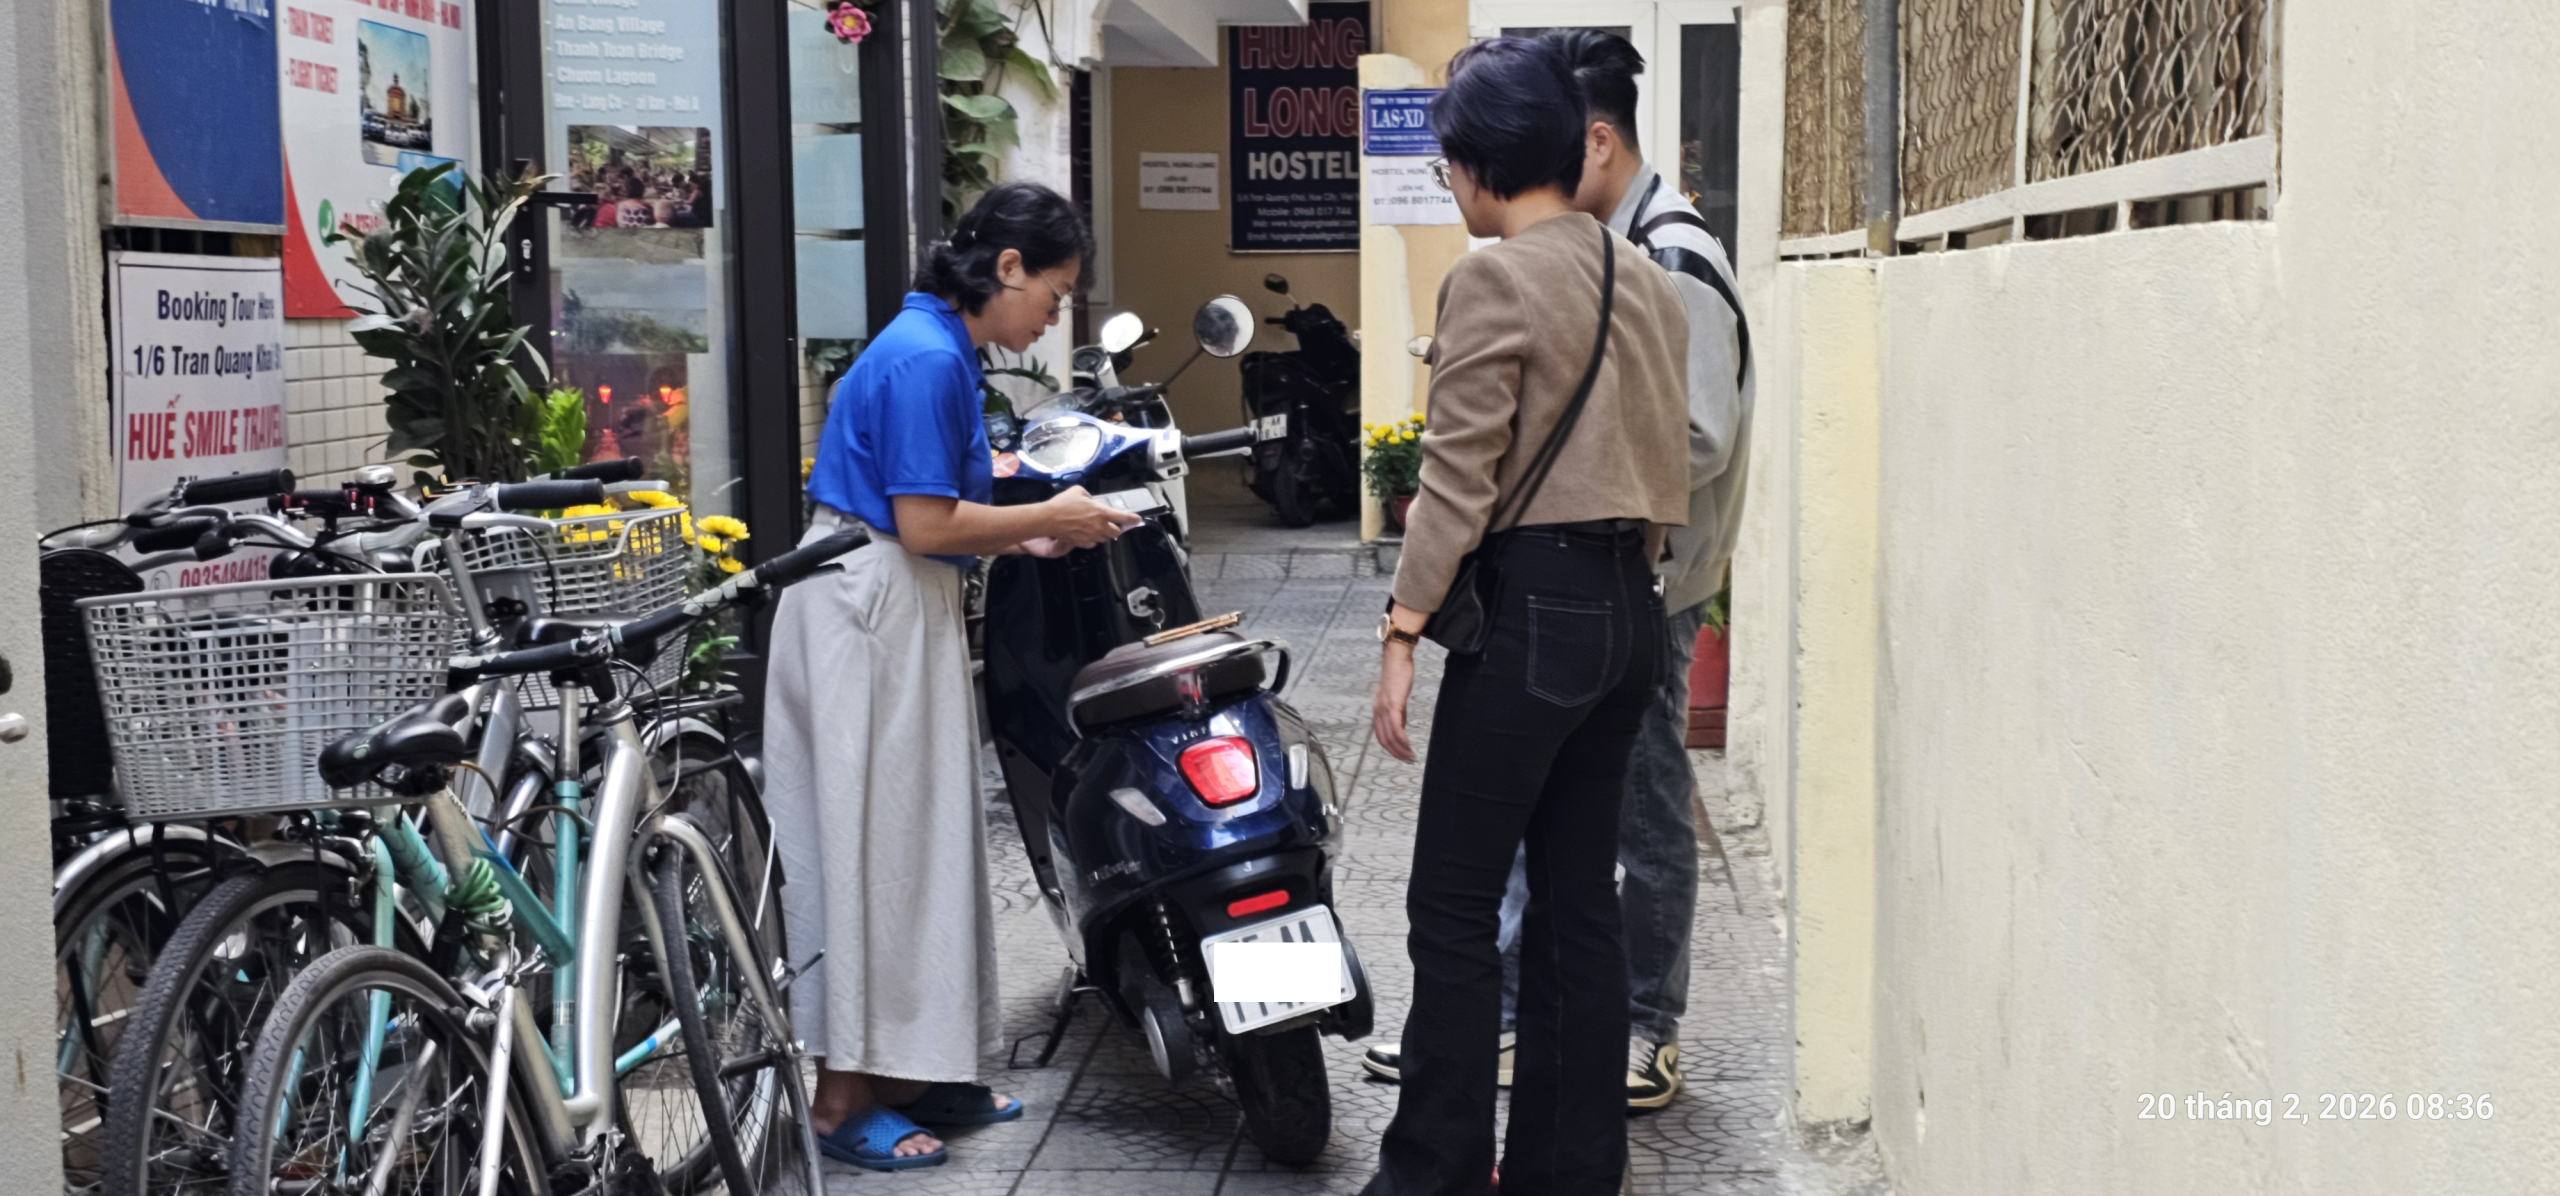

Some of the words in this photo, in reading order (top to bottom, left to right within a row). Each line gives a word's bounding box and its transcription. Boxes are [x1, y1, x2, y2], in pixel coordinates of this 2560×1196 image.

[555, 14, 575, 31] An
[577, 15, 614, 34] Bang
[616, 16, 666, 35] Village
[555, 40, 599, 58] Thanh
[602, 42, 635, 59] Toan
[637, 43, 684, 62] Bridge
[1239, 18, 1366, 70] HUNG
[557, 66, 602, 84] Chuon
[604, 67, 656, 87] Lagoon
[1244, 87, 1360, 138] LONG
[1371, 109, 1425, 129] LAS-XD
[1248, 151, 1360, 181] HOSTEL
[1371, 168, 1405, 176] HOSTEL
[1411, 196, 1453, 205] 8017744
[158, 289, 227, 328] Booking
[232, 291, 255, 321] Tour
[133, 344, 165, 380] 1/6
[172, 346, 209, 376] Tran
[214, 344, 253, 380] Quang
[128, 394, 182, 461] HUẾ
[183, 409, 239, 460] SMILE
